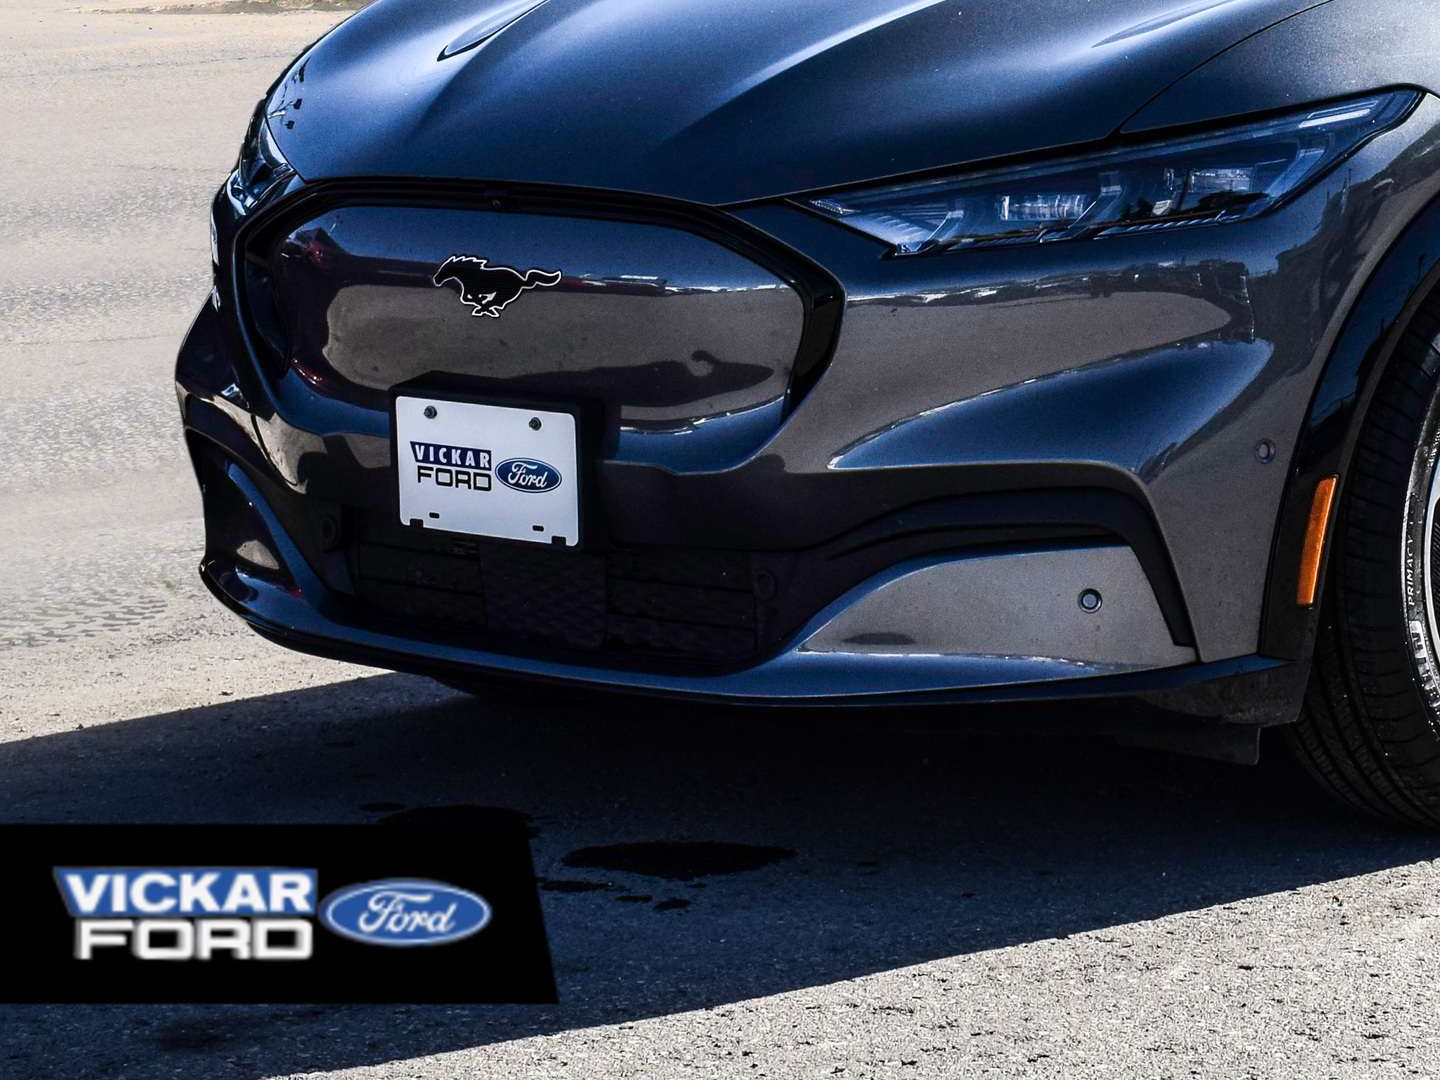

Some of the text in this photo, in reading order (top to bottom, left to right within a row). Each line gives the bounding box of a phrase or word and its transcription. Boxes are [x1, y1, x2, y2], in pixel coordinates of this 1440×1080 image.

[415, 445, 490, 468] VICKAR
[417, 465, 492, 492] FORD
[507, 461, 549, 488] Ford
